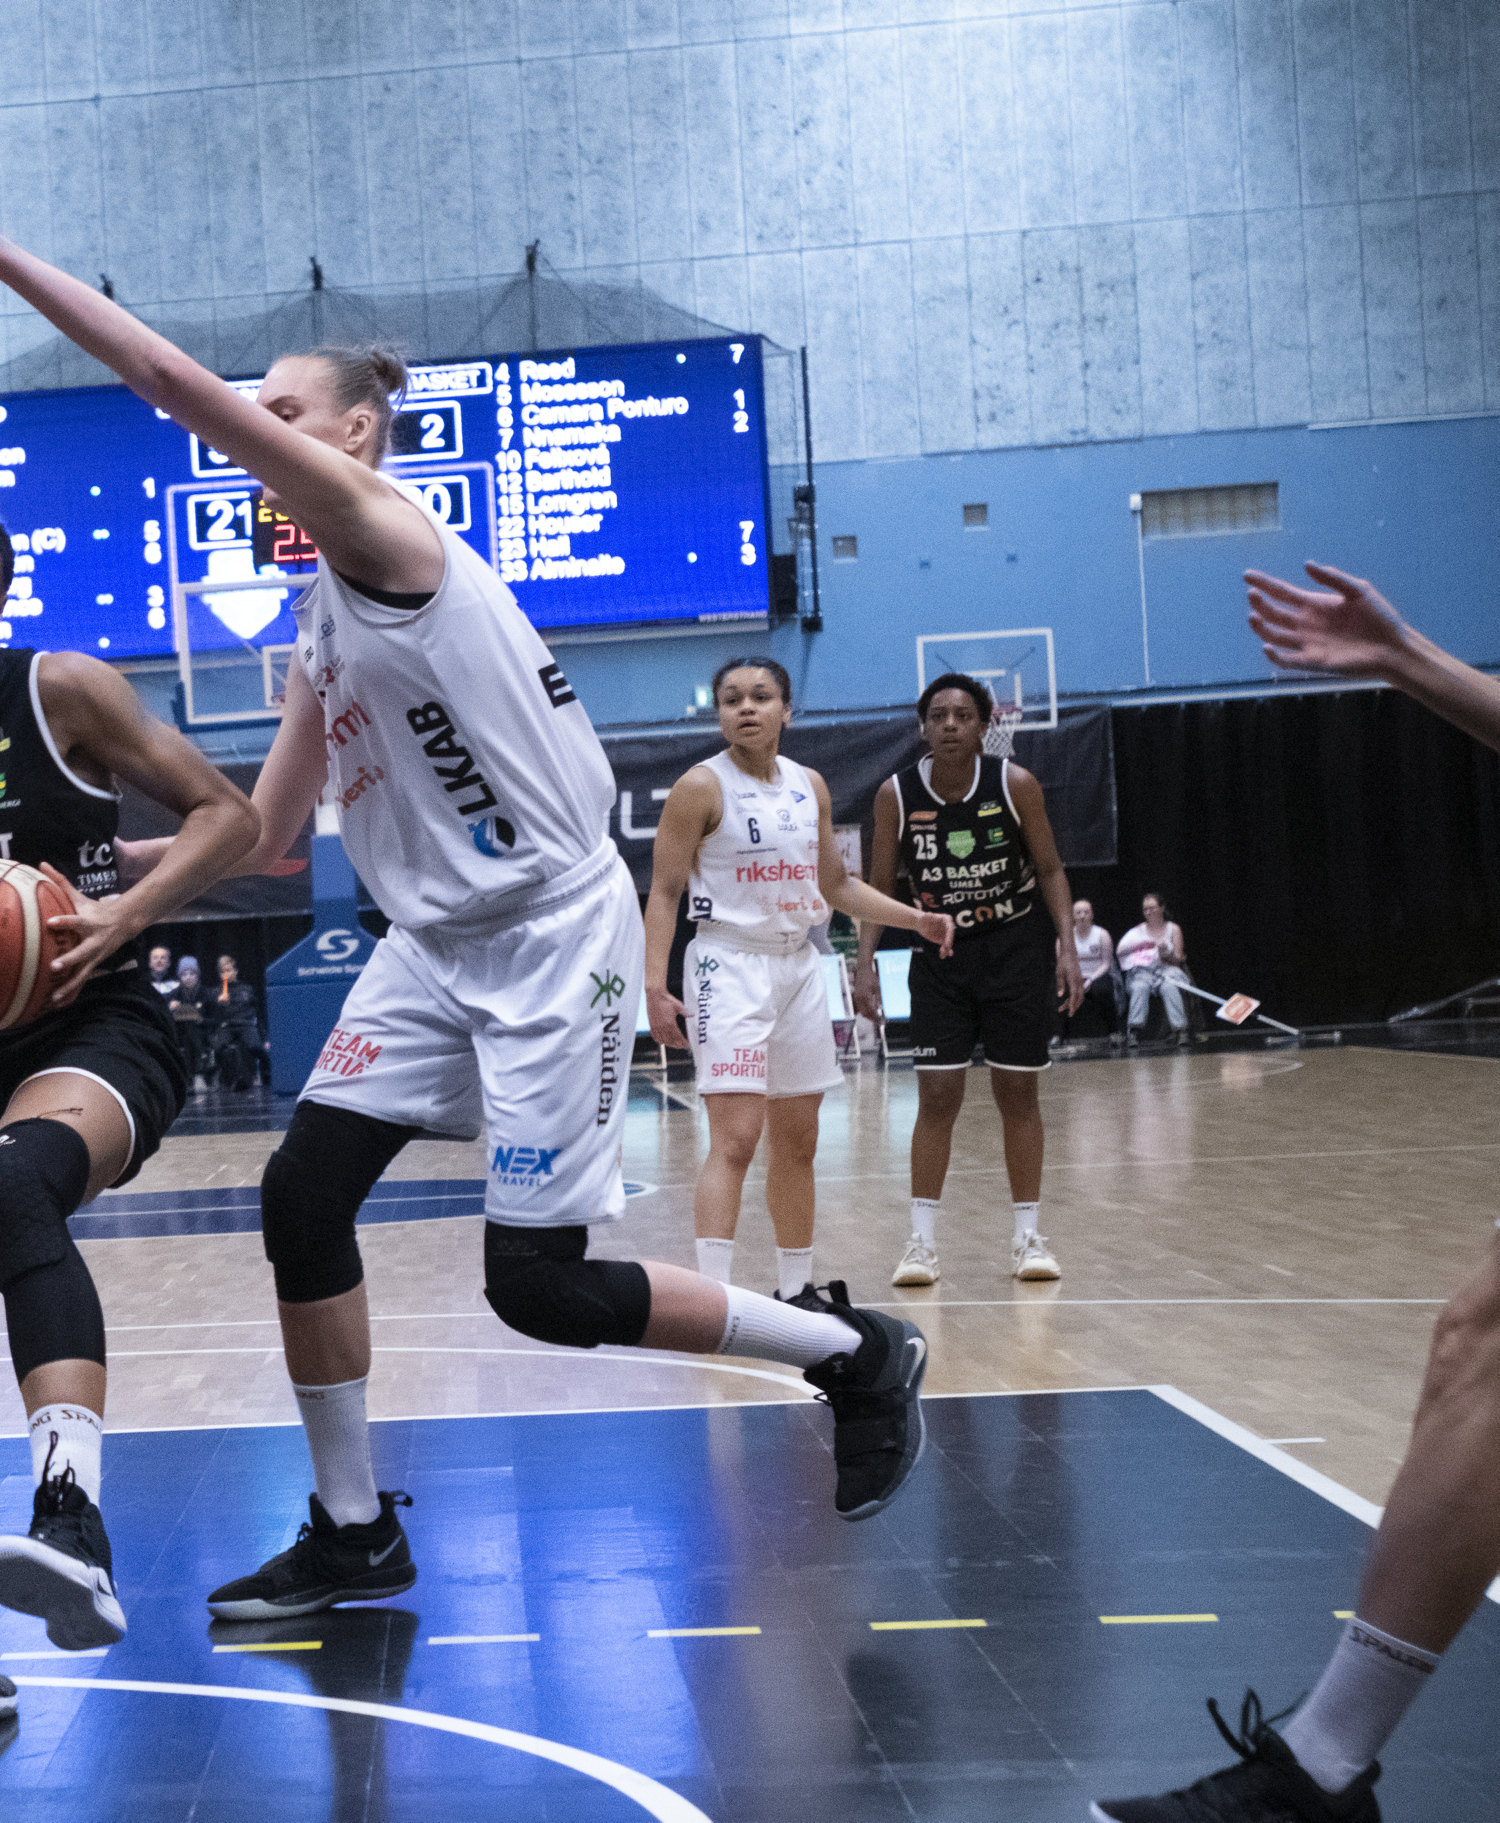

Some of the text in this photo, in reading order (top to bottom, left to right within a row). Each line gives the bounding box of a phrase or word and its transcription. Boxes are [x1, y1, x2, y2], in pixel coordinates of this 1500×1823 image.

[729, 343, 745, 364] 7
[494, 362, 510, 384] 4
[496, 383, 512, 406] 5
[733, 388, 745, 410] 1
[497, 406, 513, 428] 6
[733, 410, 749, 431] 2
[419, 413, 446, 449] 2
[498, 427, 514, 450] 7
[495, 450, 522, 473] 10
[142, 477, 155, 498] 1
[496, 472, 523, 494] 12
[498, 493, 525, 516] 15
[206, 499, 252, 541] 21
[498, 515, 526, 539] 22
[740, 521, 754, 543] 7
[499, 537, 527, 561] 23
[741, 543, 757, 565] 3
[500, 559, 529, 583] 33
[406, 701, 498, 816] LKAB
[747, 817, 761, 844] 6
[912, 833, 938, 860] 25
[921, 857, 1009, 882] A3 BASKET
[956, 900, 1014, 927] CON
[492, 1145, 562, 1175] NEX
